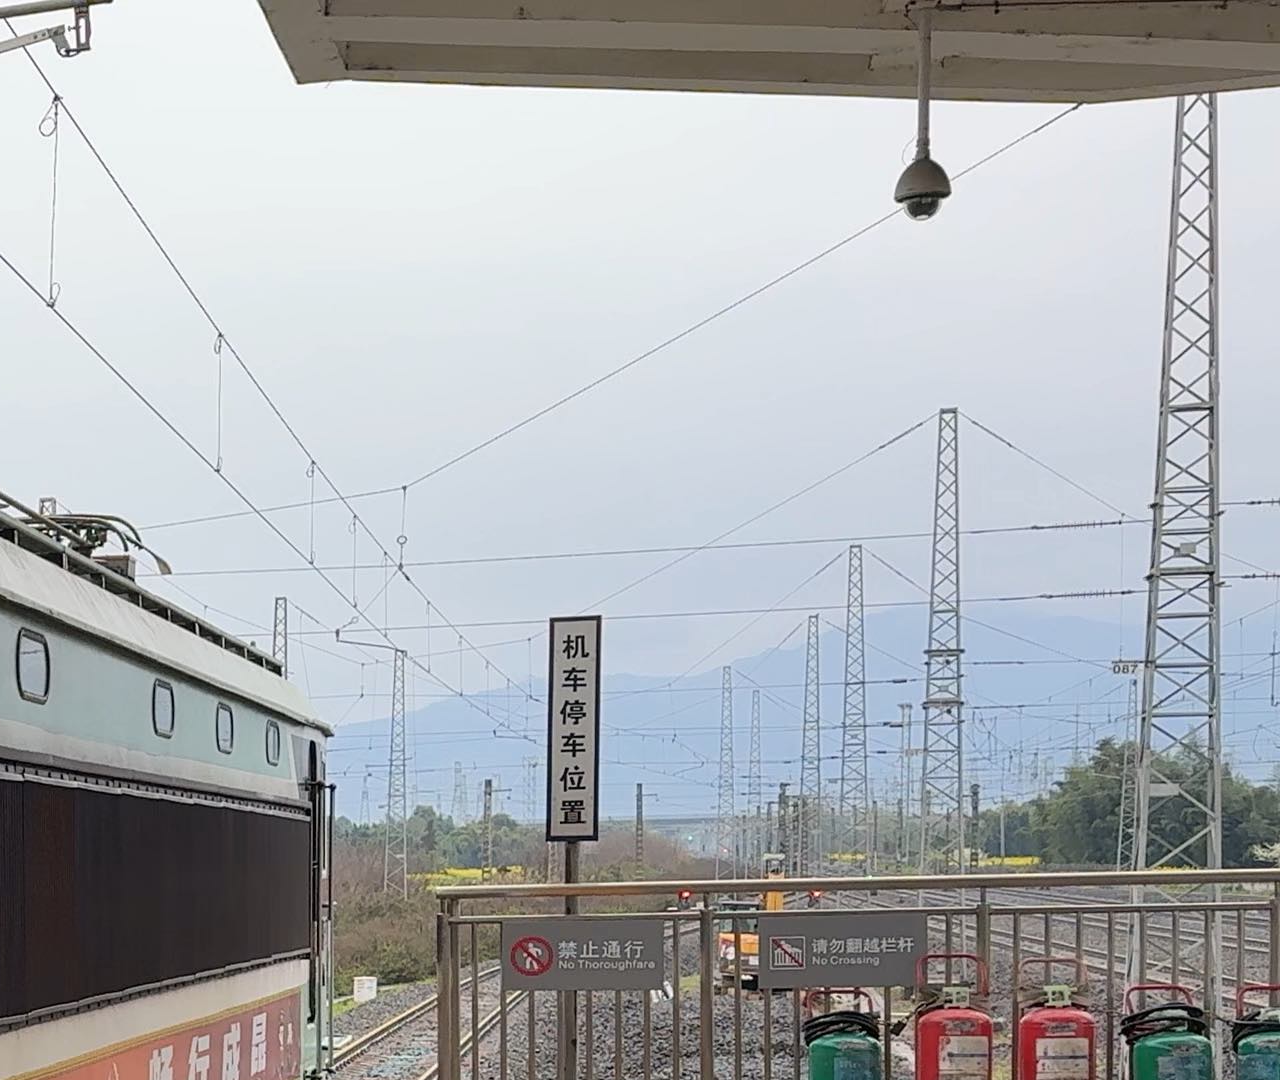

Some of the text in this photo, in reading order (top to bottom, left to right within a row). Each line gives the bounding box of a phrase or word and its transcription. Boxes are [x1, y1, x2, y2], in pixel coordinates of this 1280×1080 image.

[1112, 664, 1138, 674] 087
[559, 634, 590, 825] 机车停车位置
[558, 940, 645, 959] 禁止通行
[811, 936, 914, 954] 请勿翻越栏杆
[558, 960, 655, 971] No Thoroughfare
[812, 955, 880, 966] No Crossing
